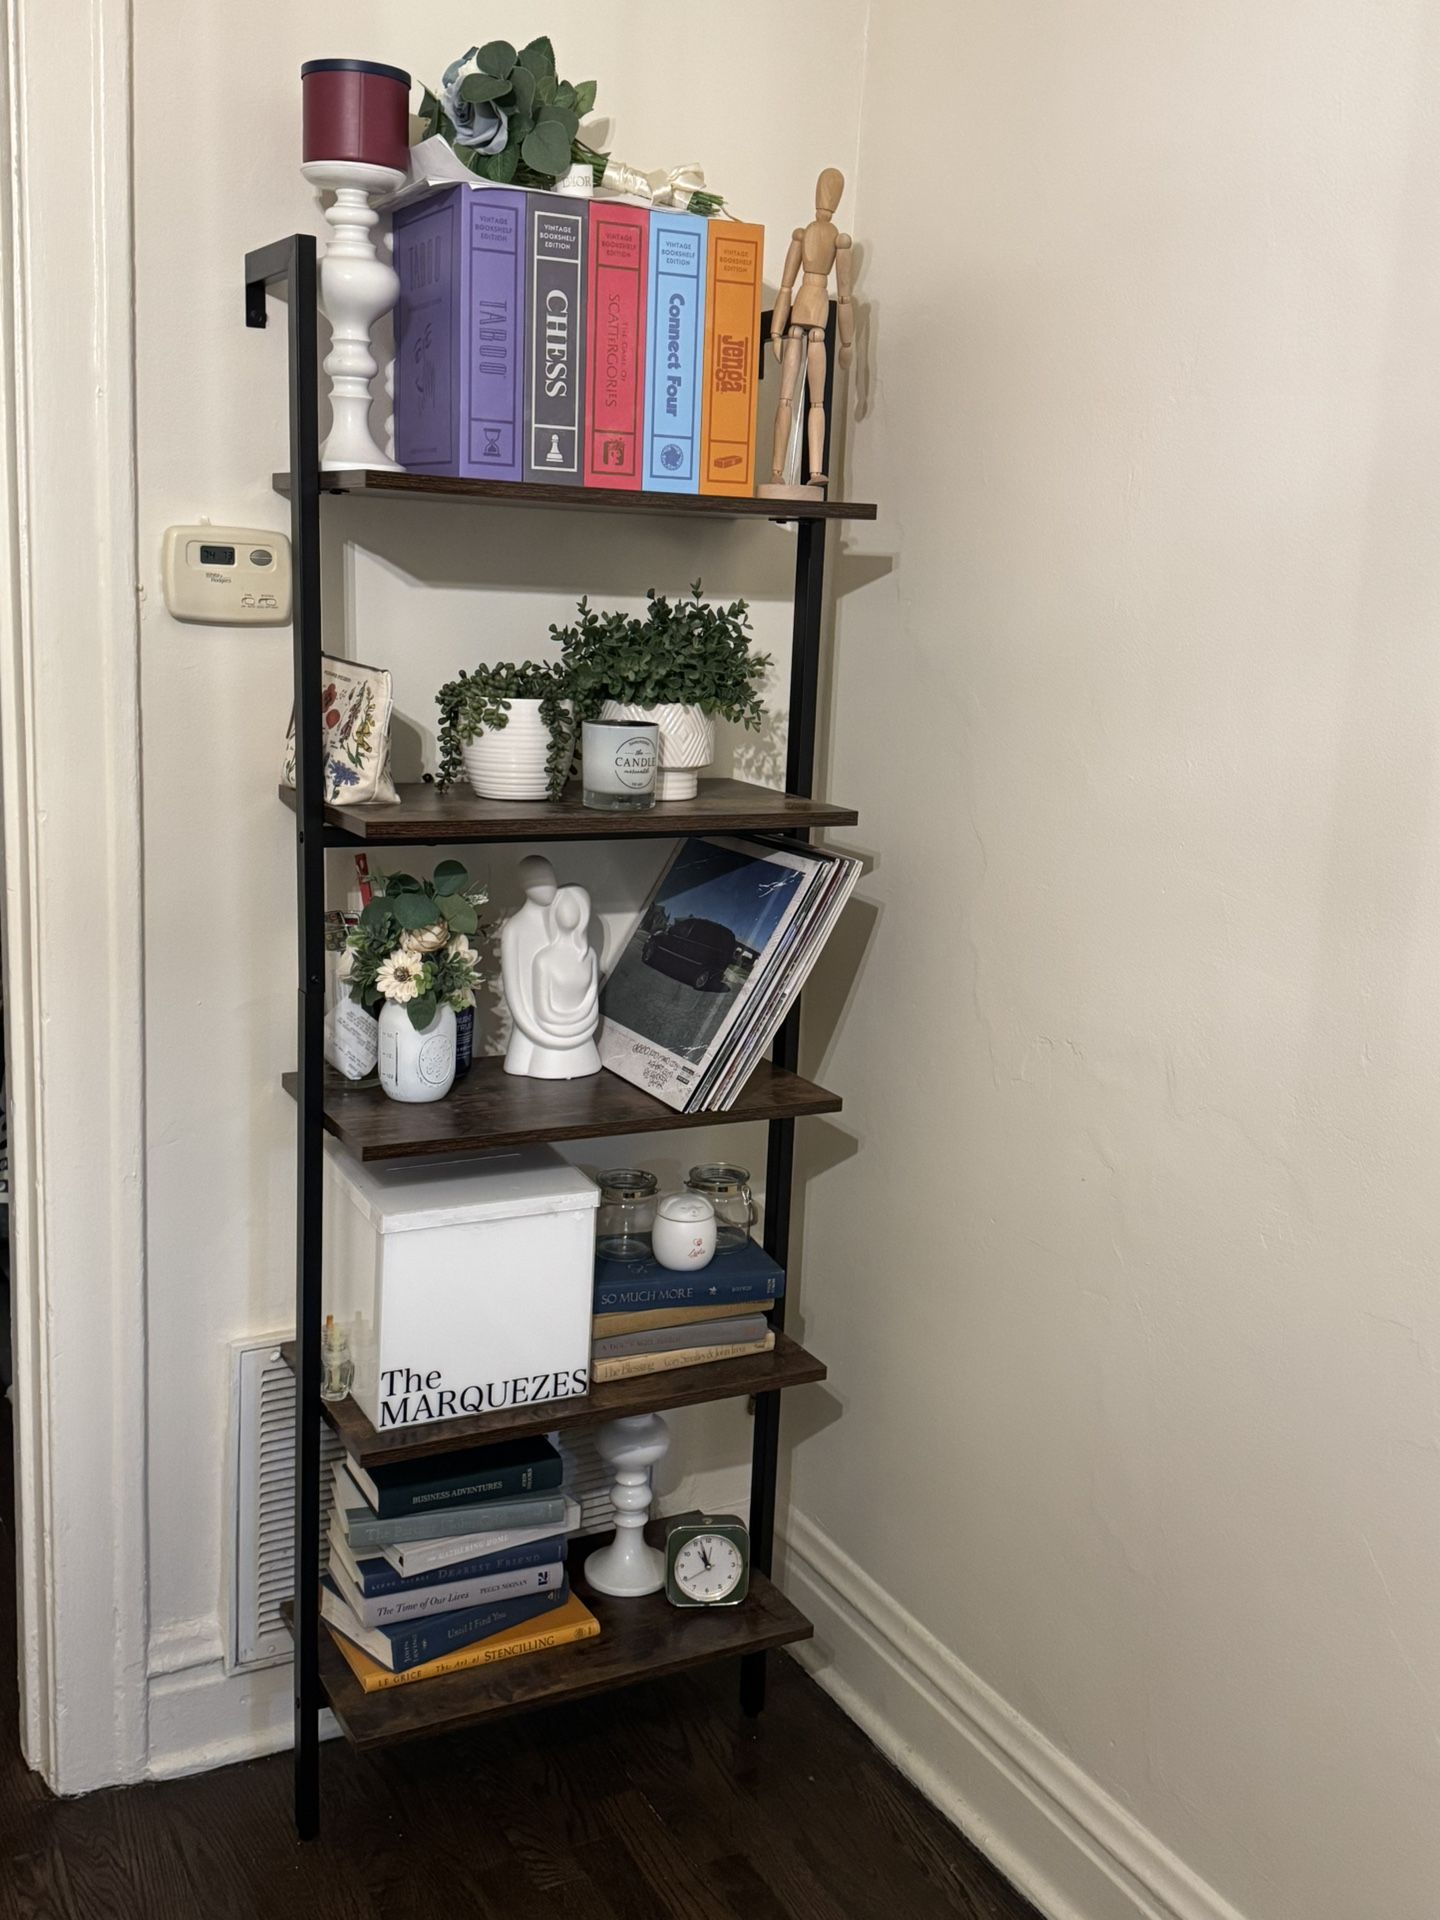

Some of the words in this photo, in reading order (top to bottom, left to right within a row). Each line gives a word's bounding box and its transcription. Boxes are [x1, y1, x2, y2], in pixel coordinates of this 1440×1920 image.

[480, 216, 508, 225] VINTAGE
[475, 224, 512, 234] BOOKSHELF
[544, 224, 572, 233] VINTAGE
[480, 233, 507, 242] EDITION
[540, 232, 576, 242] BOOKSHELF
[606, 233, 632, 242] VINTAGE
[545, 241, 571, 250] EDITION
[601, 241, 637, 250] BOOKSHELF
[666, 241, 691, 250] VINTAGE
[606, 249, 631, 258] EDITION
[661, 249, 695, 259] BOOKSHELF
[723, 249, 748, 257] VINTAGE
[666, 258, 690, 266] EDITION
[719, 256, 752, 266] BOOKSHELF
[723, 265, 747, 273] EDITION
[667, 293, 685, 370] Connect
[479, 300, 507, 375] TABOO
[545, 289, 569, 397] CHESS
[605, 293, 621, 407] SCATTERGORIES
[715, 335, 747, 393] Jenga
[666, 375, 682, 417] Four
[615, 757, 656, 767] CANDLE
[601, 1293, 617, 1305] SO
[619, 1290, 656, 1303] MUCH
[659, 1287, 693, 1300] MORE
[381, 1368, 442, 1397] The
[379, 1368, 588, 1428] MARQUEZES
[412, 1490, 450, 1505] BUSINESS
[451, 1480, 504, 1498] ADVENTURES
[437, 1562, 491, 1580] DEAREST
[496, 1554, 542, 1569] FRIEND
[377, 1606, 394, 1617] The
[396, 1603, 419, 1614] Time
[419, 1598, 430, 1610] of
[430, 1596, 447, 1607] Our
[448, 1591, 470, 1603] Lives
[447, 1625, 468, 1640] Until
[474, 1616, 492, 1631] Find
[492, 1610, 507, 1622] You
[393, 1670, 422, 1684] GRICE
[435, 1663, 452, 1673] The
[454, 1659, 469, 1669] Art
[484, 1635, 555, 1662] STENCILLING
